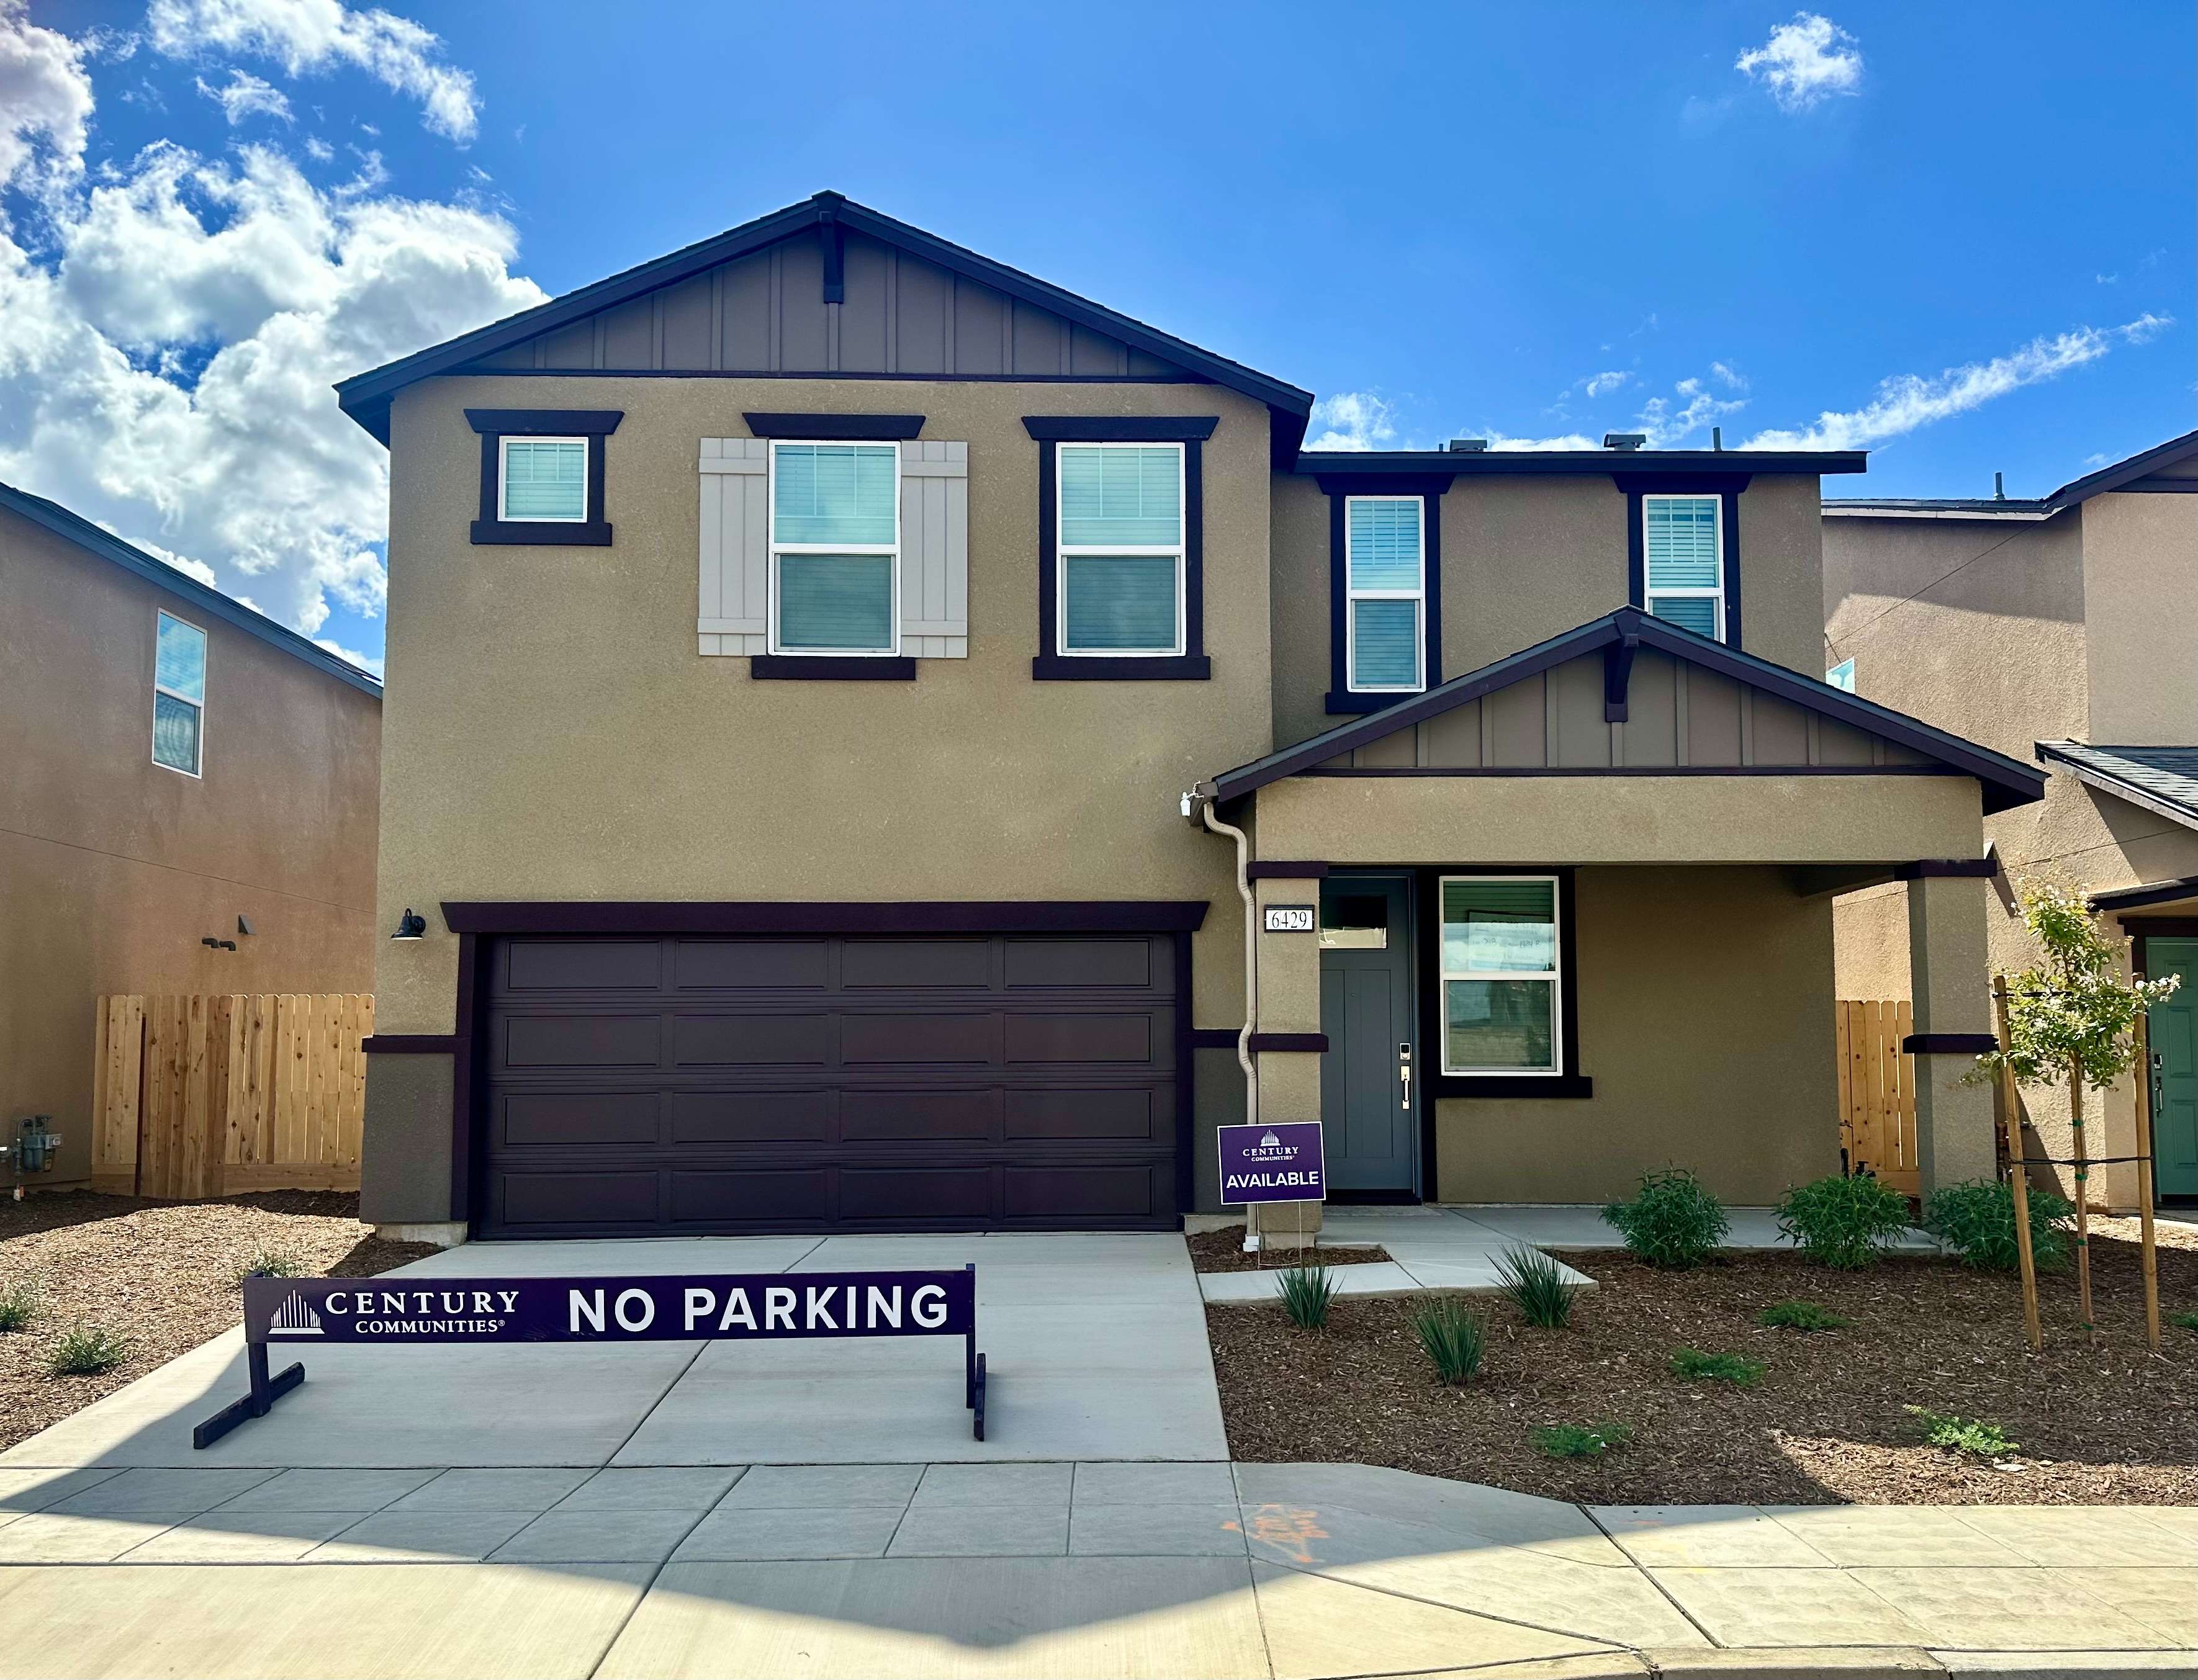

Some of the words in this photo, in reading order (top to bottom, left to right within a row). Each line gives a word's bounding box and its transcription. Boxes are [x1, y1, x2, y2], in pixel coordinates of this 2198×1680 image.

[1272, 911, 1307, 928] 6429
[1242, 1146, 1299, 1156] CENTURY
[1226, 1171, 1319, 1188] AVAILABLE
[325, 1291, 519, 1314] CENTURY
[569, 1288, 655, 1332] NO
[685, 1285, 947, 1331] PARKING
